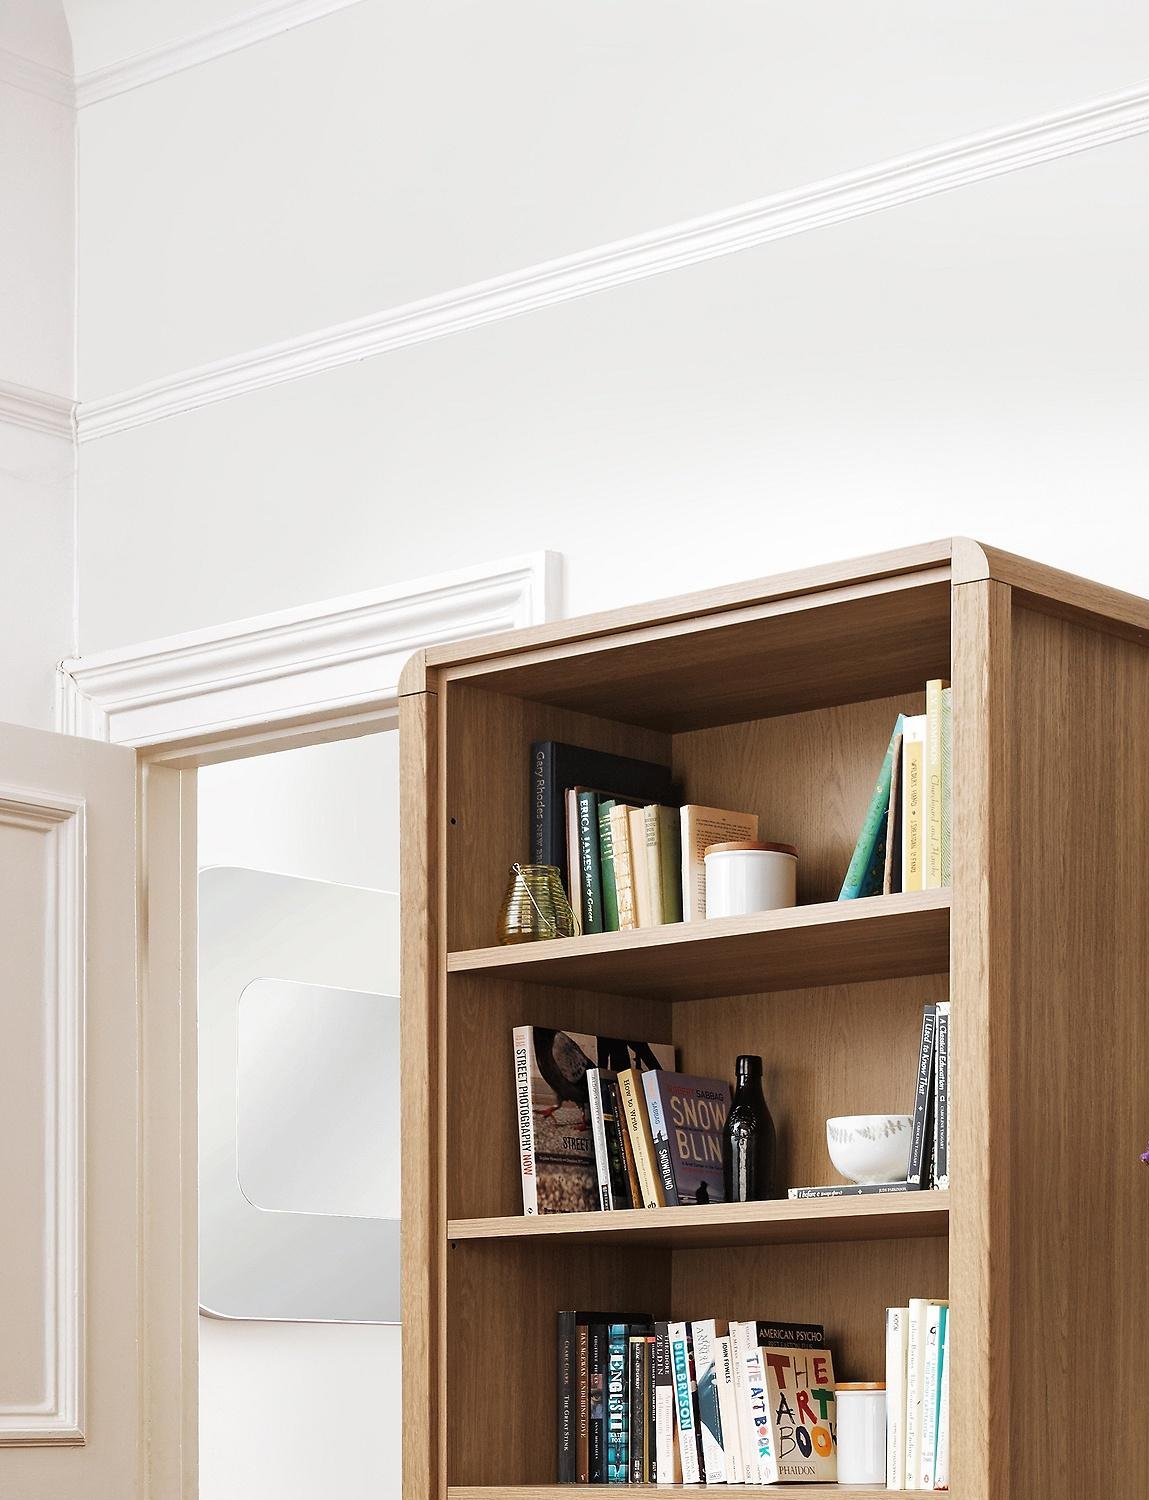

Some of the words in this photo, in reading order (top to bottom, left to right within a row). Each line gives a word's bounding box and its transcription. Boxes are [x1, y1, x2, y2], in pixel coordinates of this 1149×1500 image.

[535, 751, 545, 777] Gary
[536, 779, 545, 819] Rhodes
[580, 799, 590, 834] ERICA
[582, 836, 592, 872] JAMES
[924, 1023, 932, 1044] Used
[922, 1044, 929, 1053] to
[516, 1048, 528, 1084] STREET
[920, 1054, 929, 1076] Know
[623, 1079, 632, 1097] How
[696, 1088, 724, 1101] SABBAG
[918, 1077, 928, 1095] That
[627, 1099, 633, 1108] to
[670, 1095, 727, 1130] SNOW
[518, 1085, 532, 1152] PHOTOGRAPHY
[629, 1109, 638, 1132] Write
[562, 1136, 590, 1152] STREET
[676, 1129, 723, 1163] BLIN
[522, 1154, 533, 1176] NOW
[658, 1148, 674, 1191] SNOWBLIND
[759, 1328, 794, 1340] AMERICAN
[796, 1331, 823, 1342] PSYCHO
[656, 1334, 664, 1376] ZELDIN
[674, 1342, 686, 1371] BILL
[746, 1352, 761, 1382] THE
[723, 1359, 731, 1384] FOWLES
[766, 1352, 829, 1390] THE
[609, 1354, 624, 1431] ENGLISH
[677, 1373, 692, 1430] BRYSON
[751, 1387, 765, 1413] ART
[775, 1388, 835, 1425] ART
[754, 1415, 771, 1458] BOOK
[779, 1465, 816, 1475] PHAIDON
